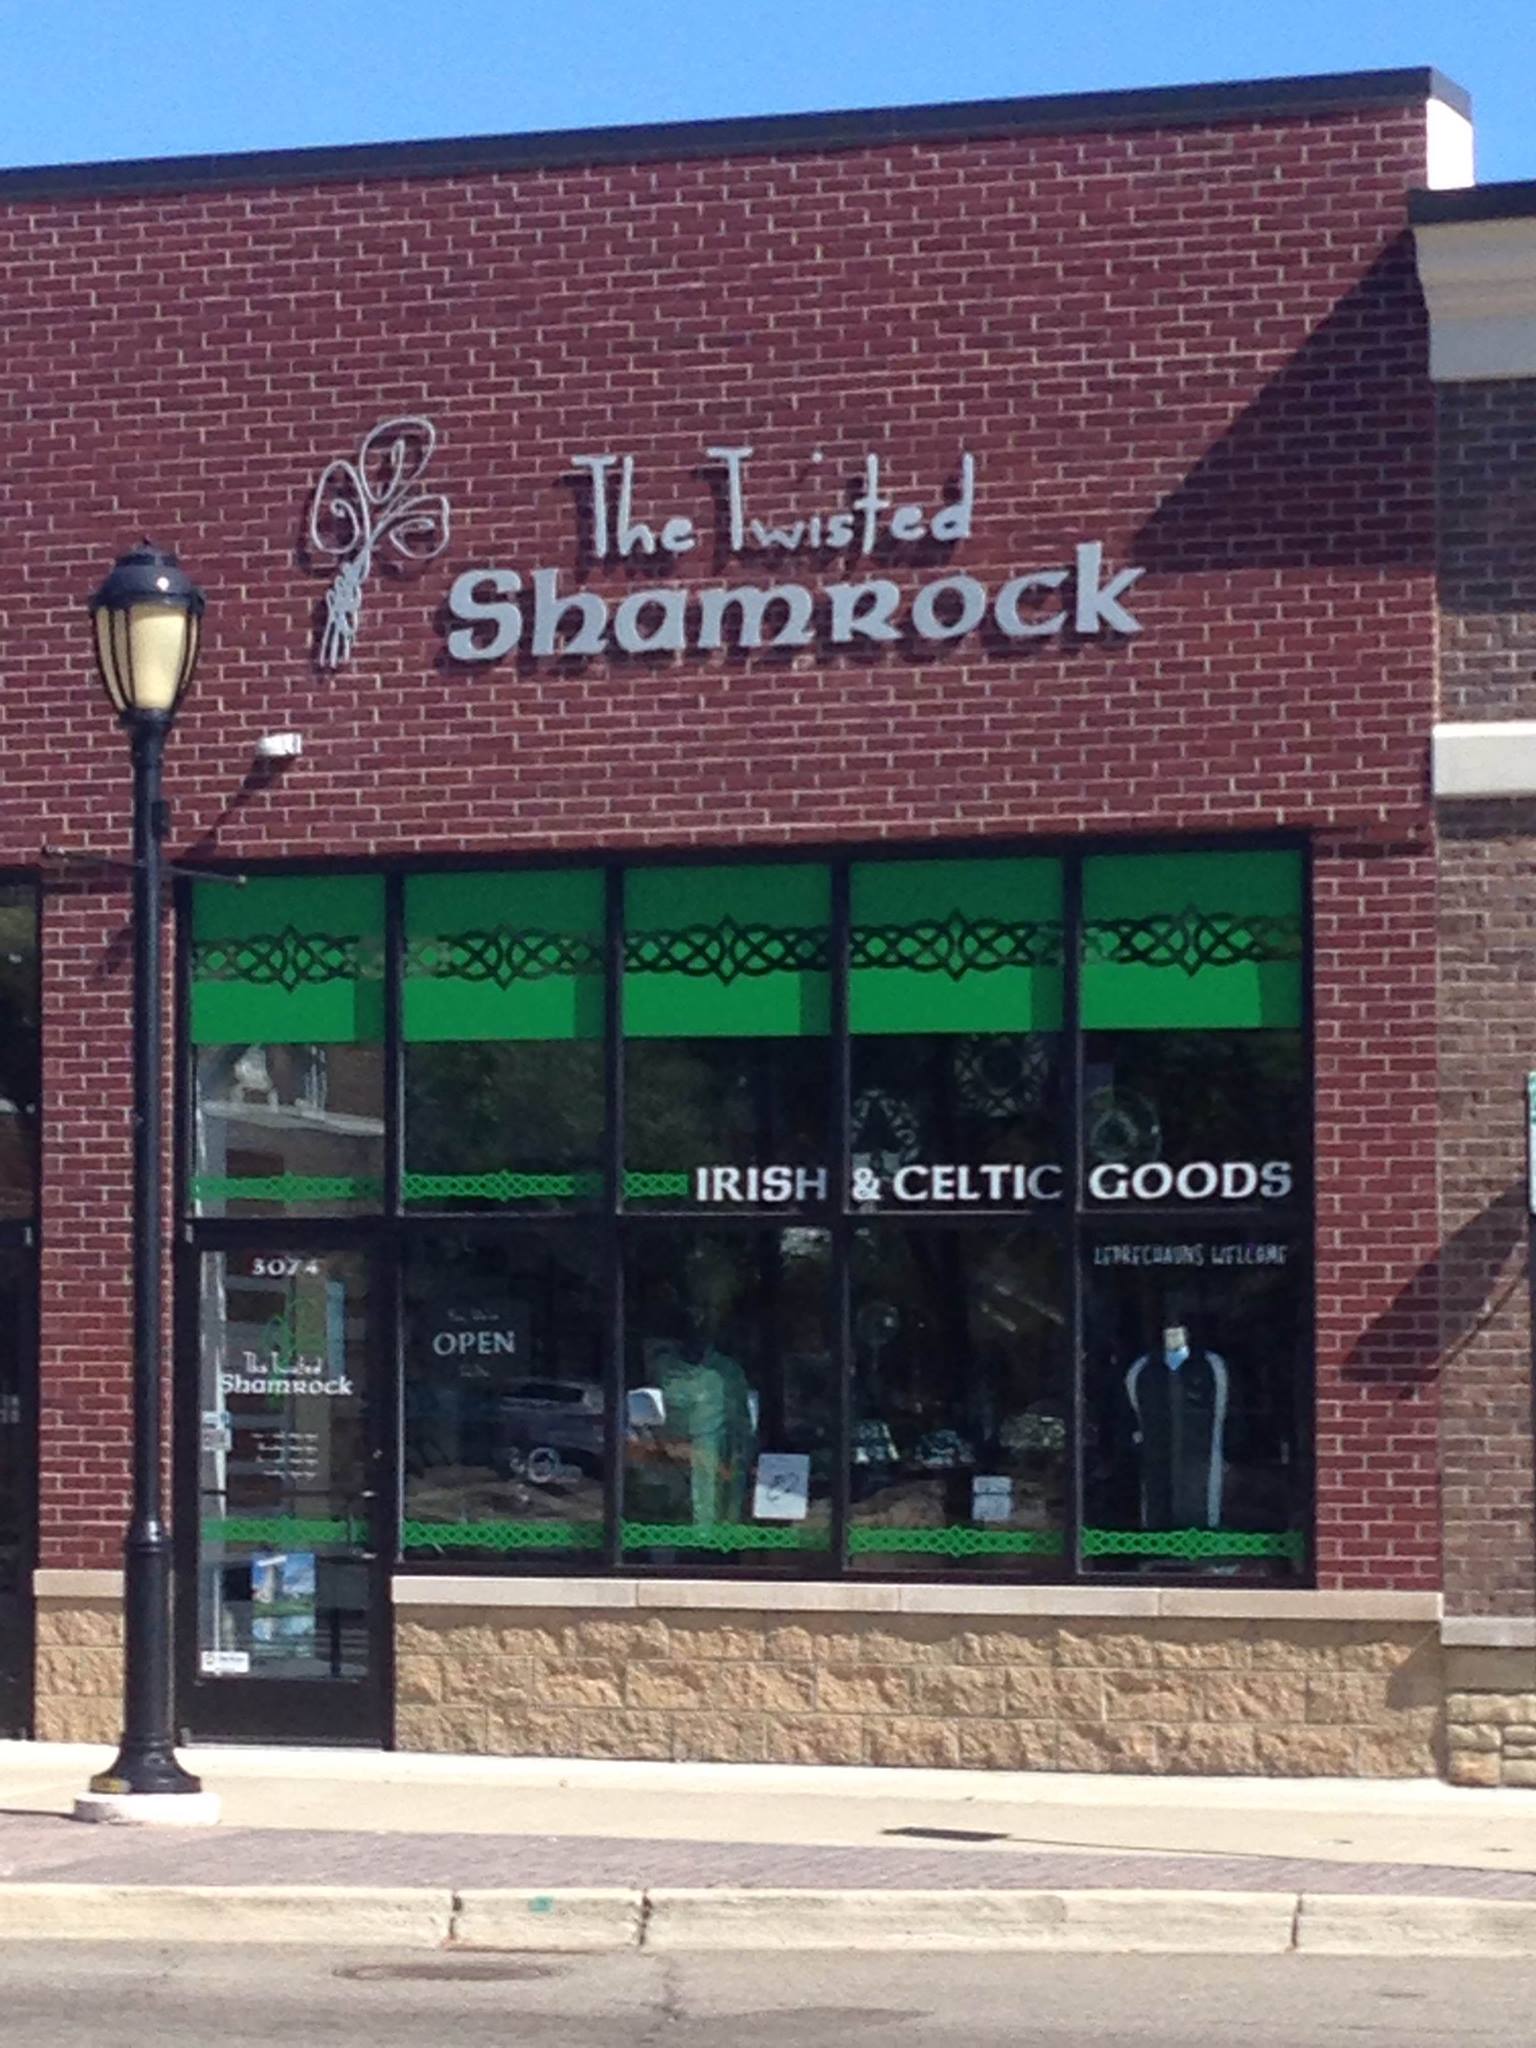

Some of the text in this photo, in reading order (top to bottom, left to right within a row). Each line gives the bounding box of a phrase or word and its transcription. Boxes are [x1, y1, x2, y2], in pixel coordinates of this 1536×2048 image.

[572, 446, 974, 557] The Twisted
[696, 1161, 1293, 1202] IRISH & CELTIC GOODS
[432, 1331, 515, 1356] OPEN
